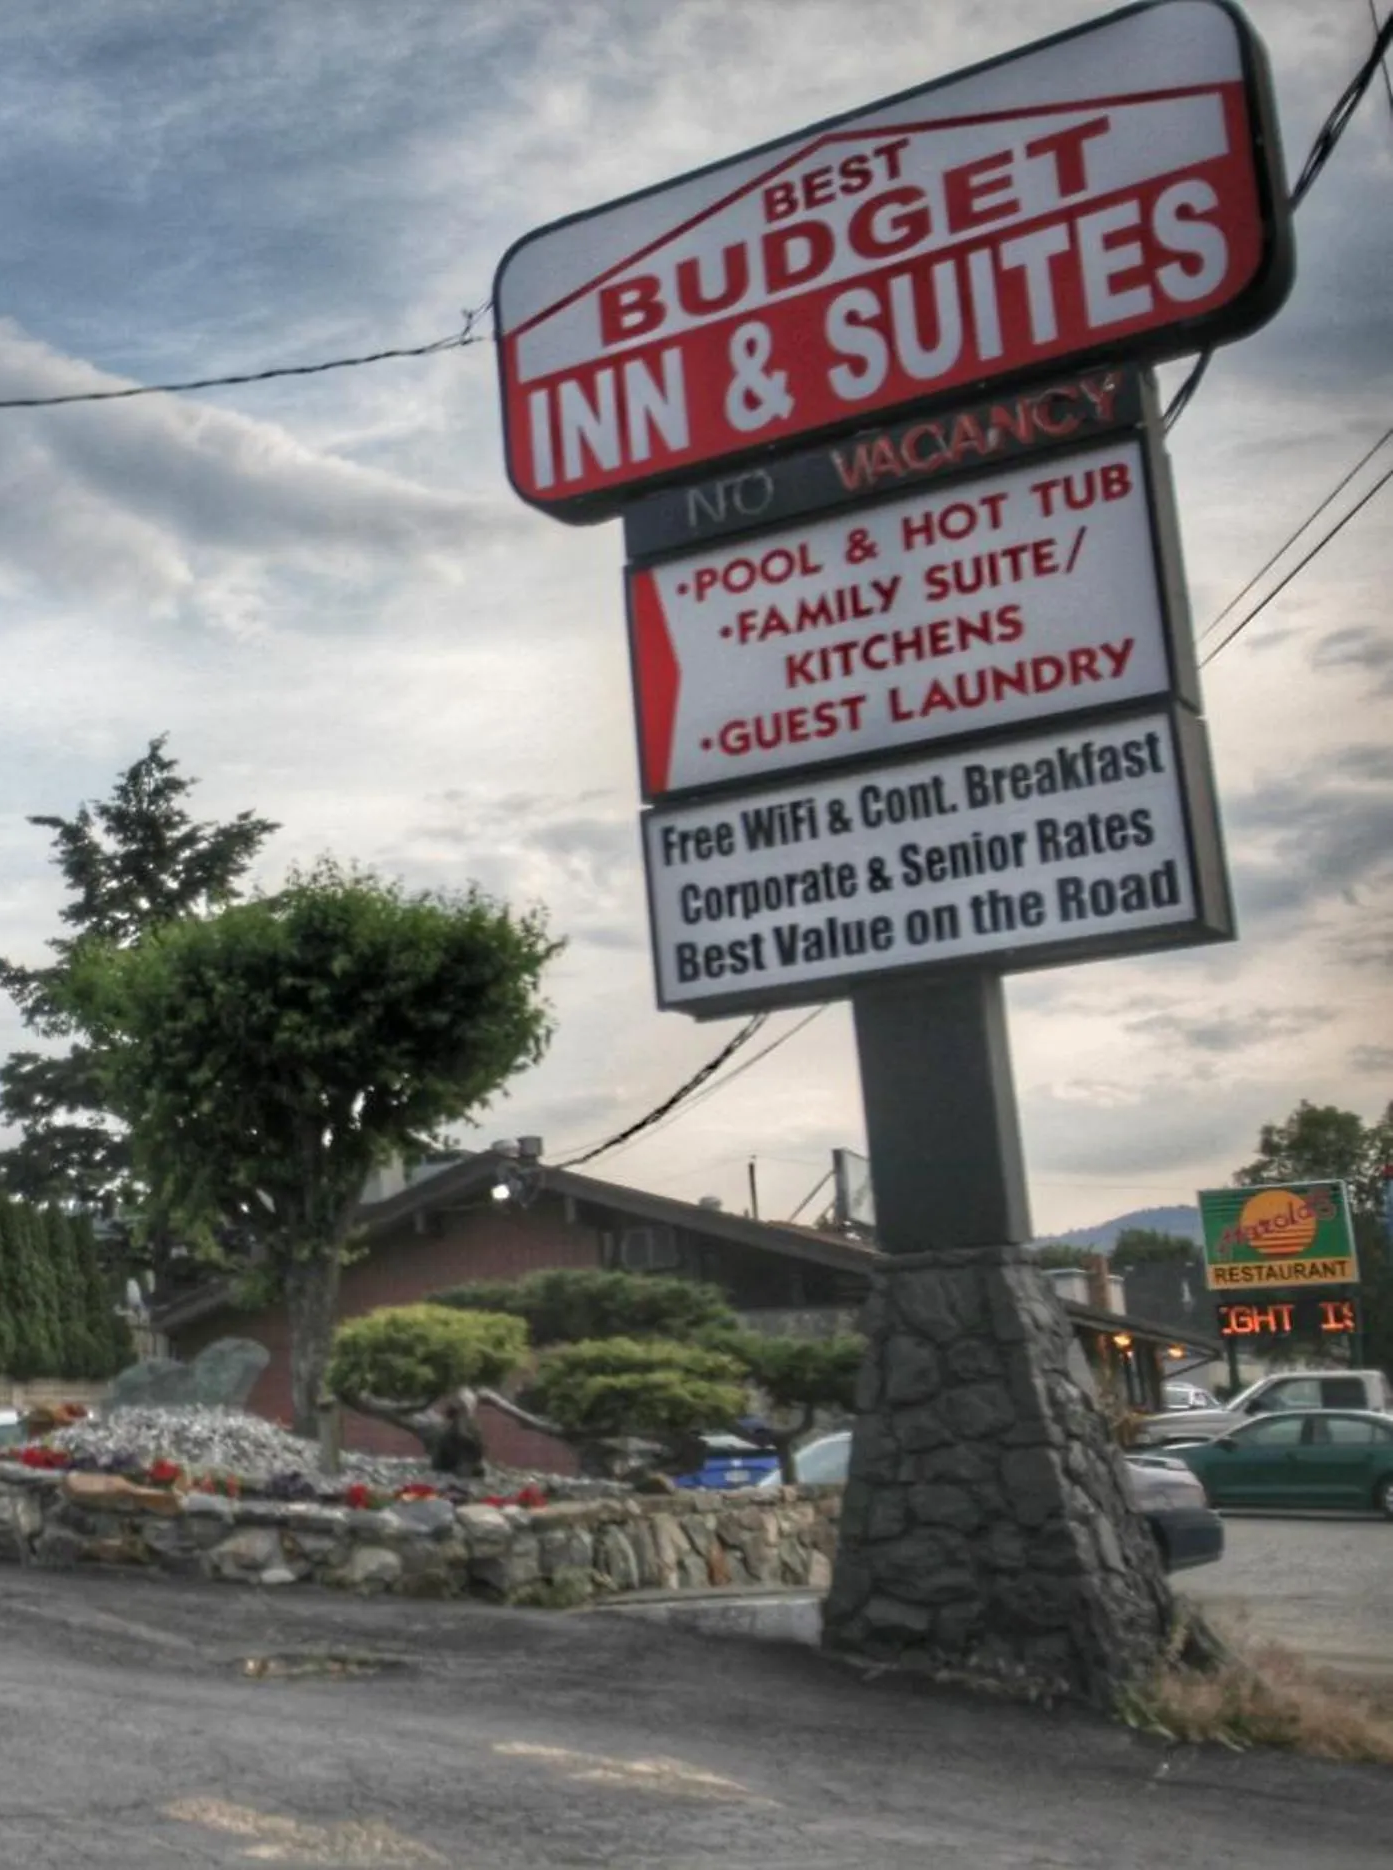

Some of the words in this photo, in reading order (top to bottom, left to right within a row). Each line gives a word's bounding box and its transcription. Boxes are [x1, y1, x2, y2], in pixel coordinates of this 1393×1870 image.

[599, 115, 1111, 347] BUDGET
[762, 136, 913, 225] BEST
[528, 348, 690, 489] INN
[724, 322, 795, 433] &
[826, 179, 1229, 400] SUITES
[686, 469, 775, 529] NO
[829, 373, 1123, 492] VACANCY
[846, 527, 878, 566] &
[900, 493, 1008, 553] HOT
[1031, 462, 1134, 518] TUB
[784, 603, 1025, 689] KITCHENS
[888, 637, 1135, 724] LAUNDRY
[660, 820, 736, 868] Free
[740, 800, 816, 852] WiFi
[827, 799, 854, 832] &
[859, 778, 959, 828] Cont.
[964, 731, 1165, 810] Breakfast
[675, 940, 765, 984] Best
[772, 912, 895, 968] Value
[905, 905, 959, 947] on
[969, 888, 1045, 934] the
[1057, 859, 1180, 922] Road
[680, 862, 859, 926] Corporate
[867, 856, 892, 892] &
[900, 830, 1027, 888] Senior
[1037, 806, 1155, 860] Rates
[1214, 1260, 1347, 1284] RESTAURANT
